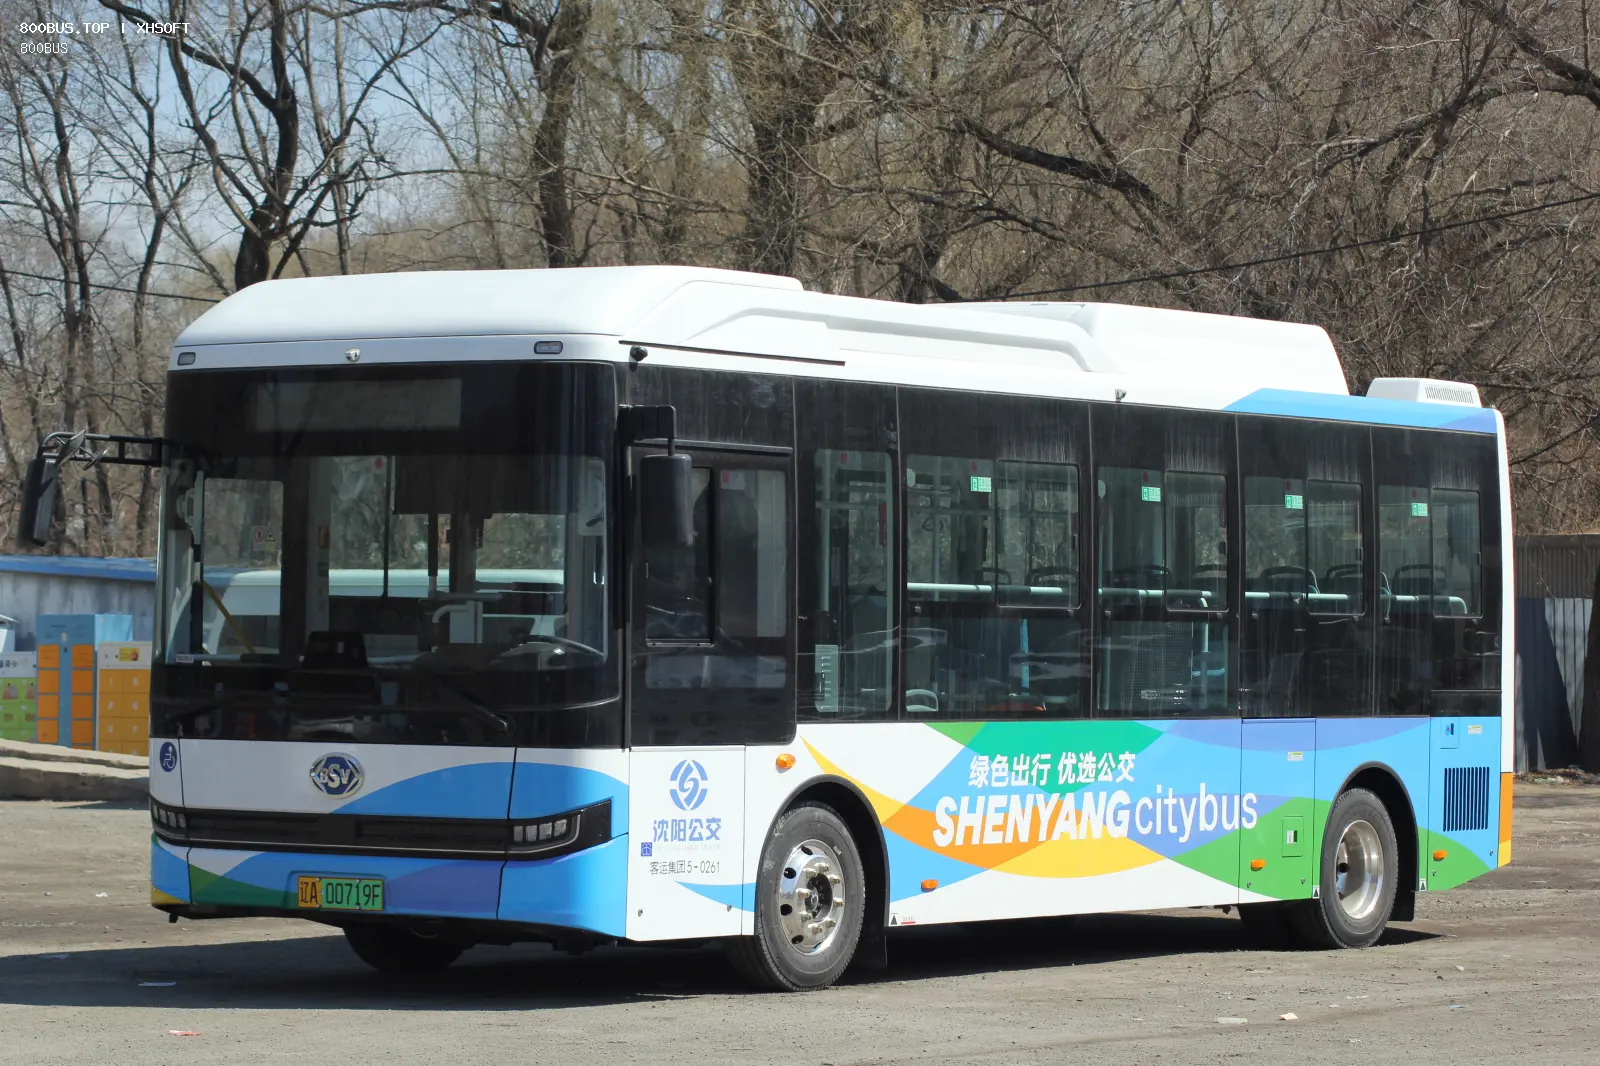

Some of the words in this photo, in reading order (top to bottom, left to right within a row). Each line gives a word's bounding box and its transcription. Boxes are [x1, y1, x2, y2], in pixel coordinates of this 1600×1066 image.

[968, 754, 1050, 788] 绿色出行
[1057, 751, 1135, 784] 优选公交
[653, 817, 721, 842] 沈阳公交
[933, 791, 1130, 846] SHENYANG
[1134, 783, 1258, 844] citybus
[325, 882, 381, 906] 00719F
